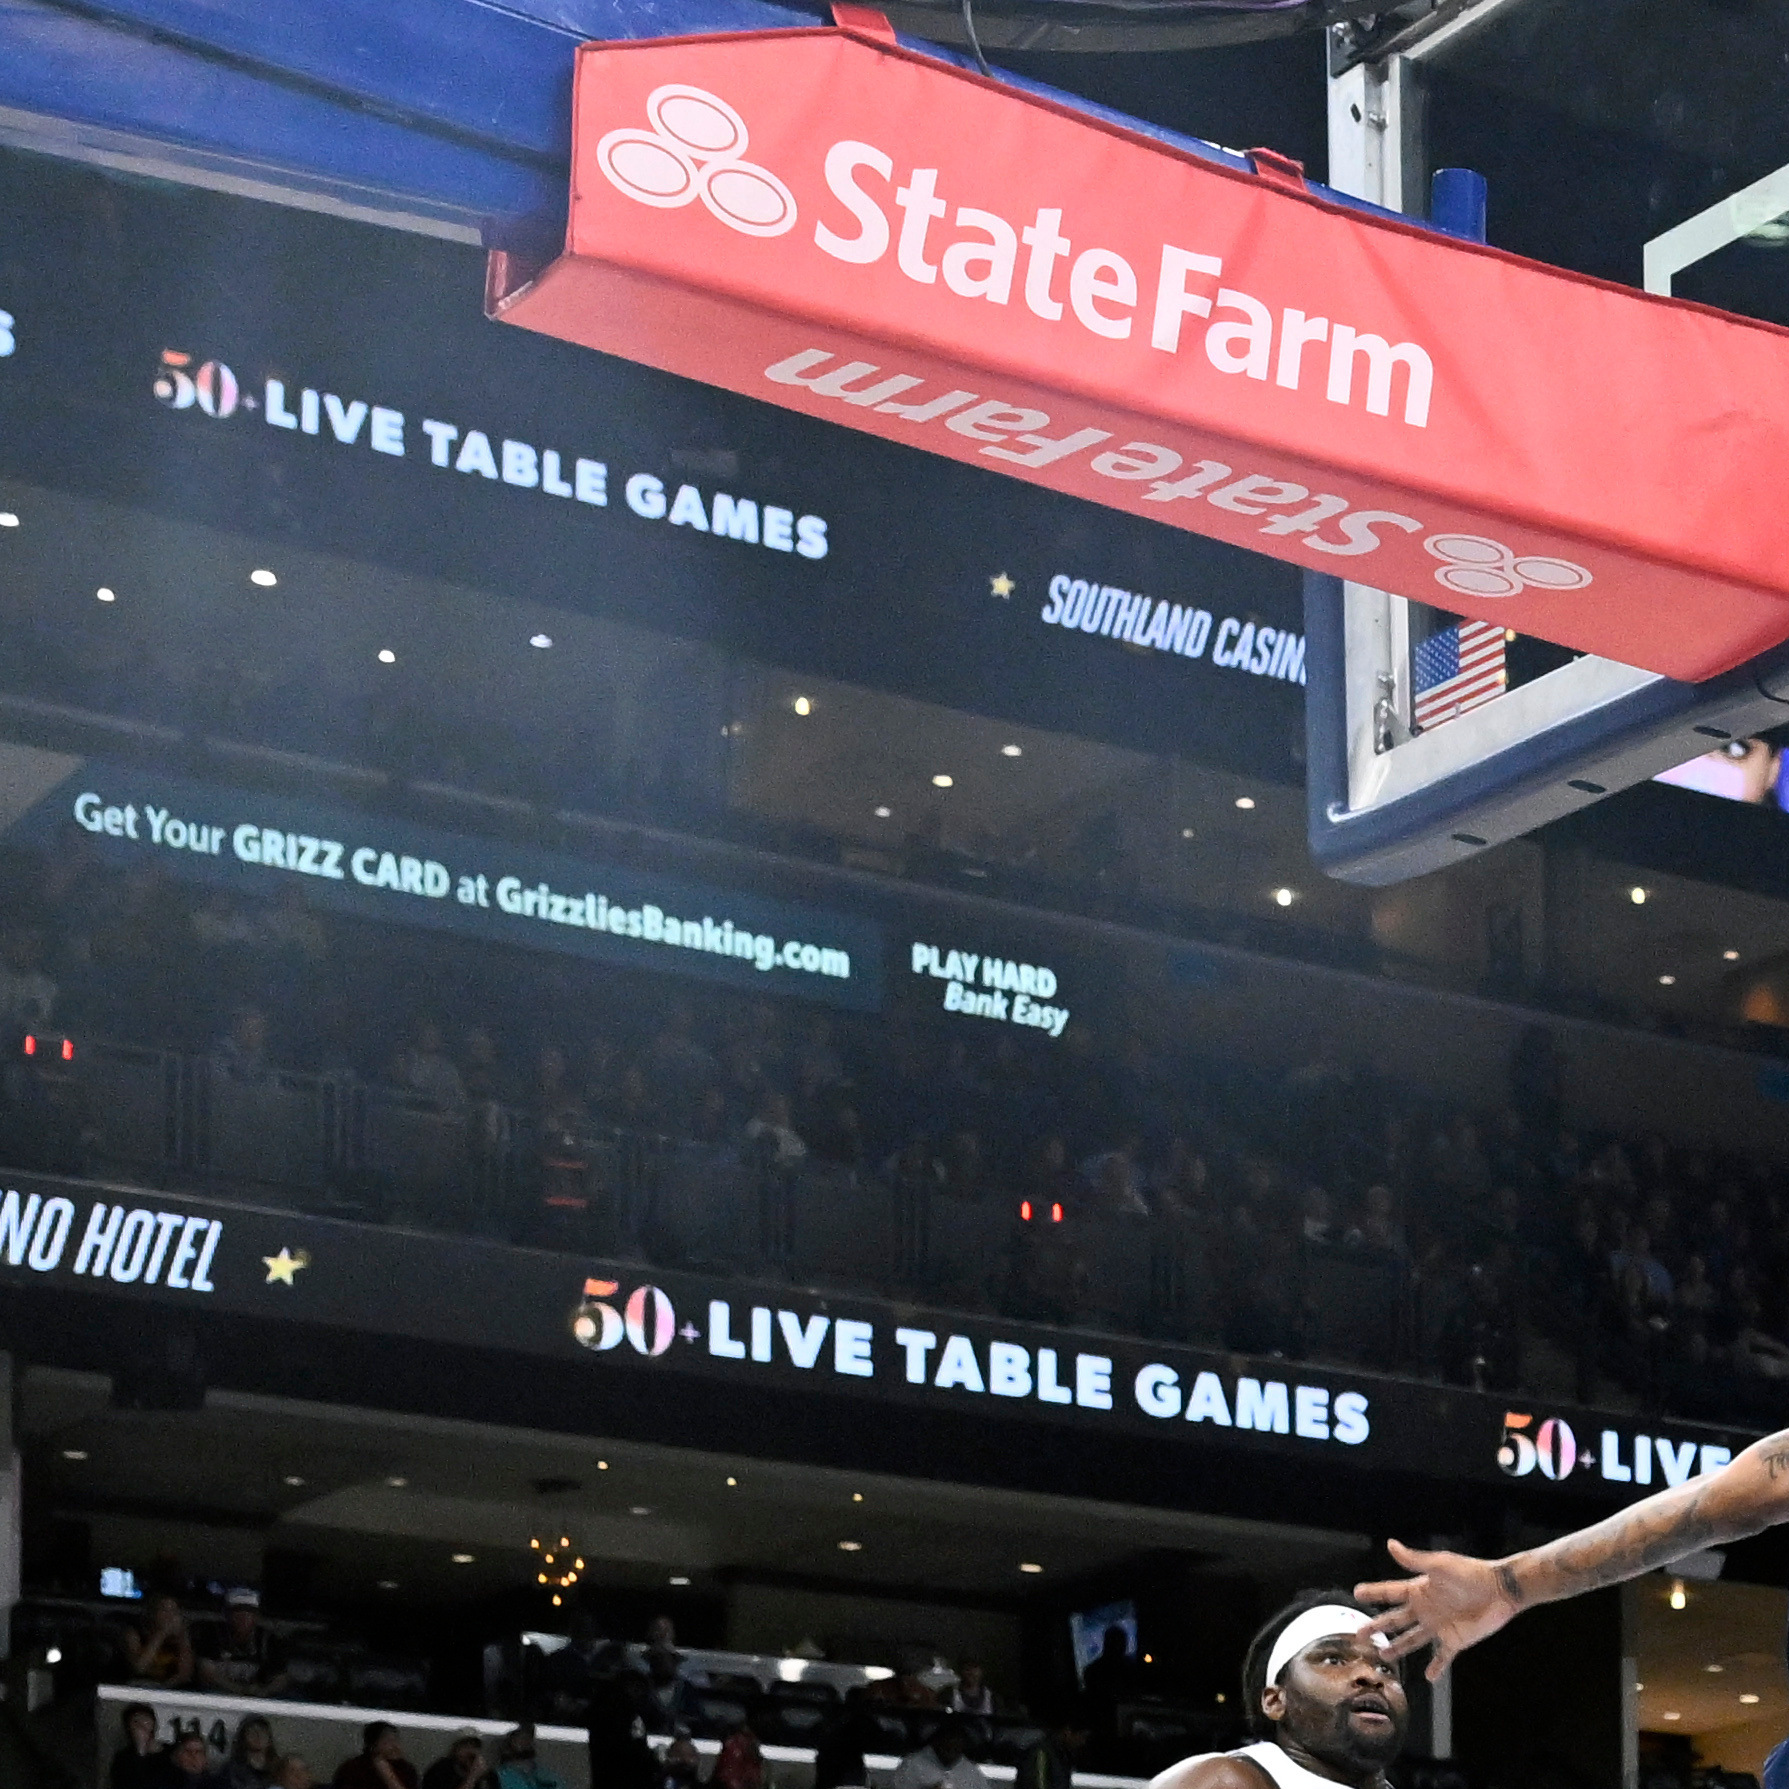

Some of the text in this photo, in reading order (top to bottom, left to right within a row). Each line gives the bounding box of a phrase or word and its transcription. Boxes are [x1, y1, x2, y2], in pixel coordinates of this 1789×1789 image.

[264, 379, 407, 457] LIVE
[422, 419, 608, 508] TABLE
[625, 472, 830, 562] GAMES
[1042, 574, 1306, 685] SOUTHLAND CASIN
[75, 792, 851, 979] Get Your GRIZZ CARD at GrizzliesBanking.com
[911, 942, 1058, 999] PLAY HARD
[944, 981, 1070, 1038] Bank Easy
[75, 1201, 223, 1293] HOTEL
[708, 1300, 875, 1377] LIVE
[895, 1327, 1113, 1411] TABLE
[1135, 1363, 1370, 1446] GAMES
